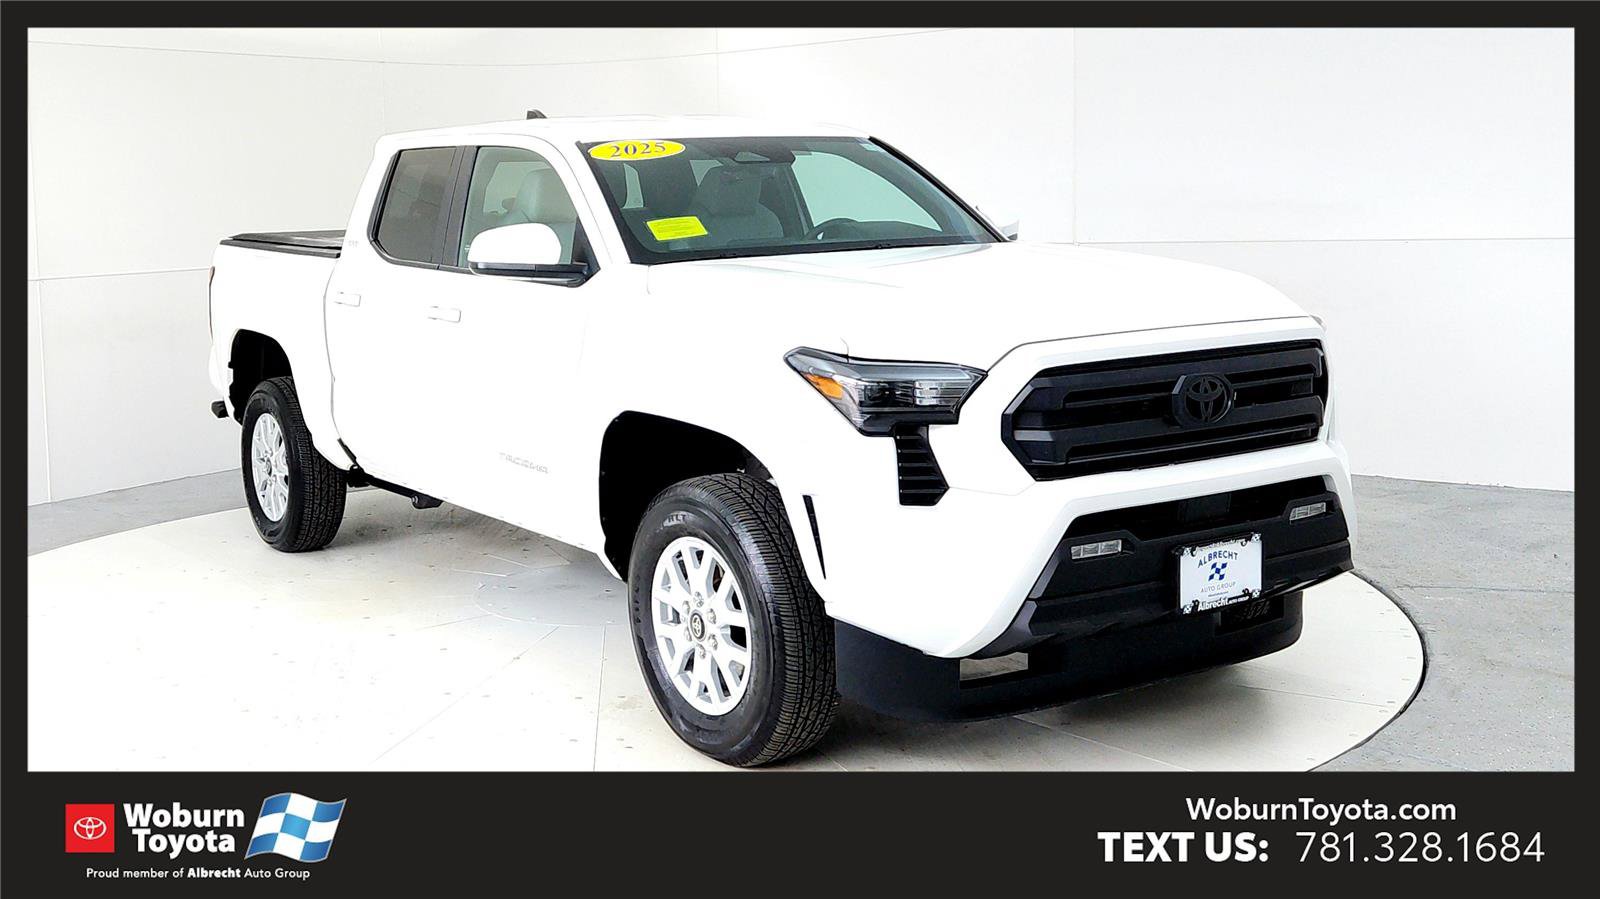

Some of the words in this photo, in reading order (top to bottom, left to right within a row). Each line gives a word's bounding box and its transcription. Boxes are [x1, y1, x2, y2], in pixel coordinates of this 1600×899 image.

[610, 141, 666, 158] 2025
[1198, 550, 1238, 568] ALBRECHT
[1217, 581, 1236, 590] GROUP
[1198, 597, 1229, 611] Albrecht
